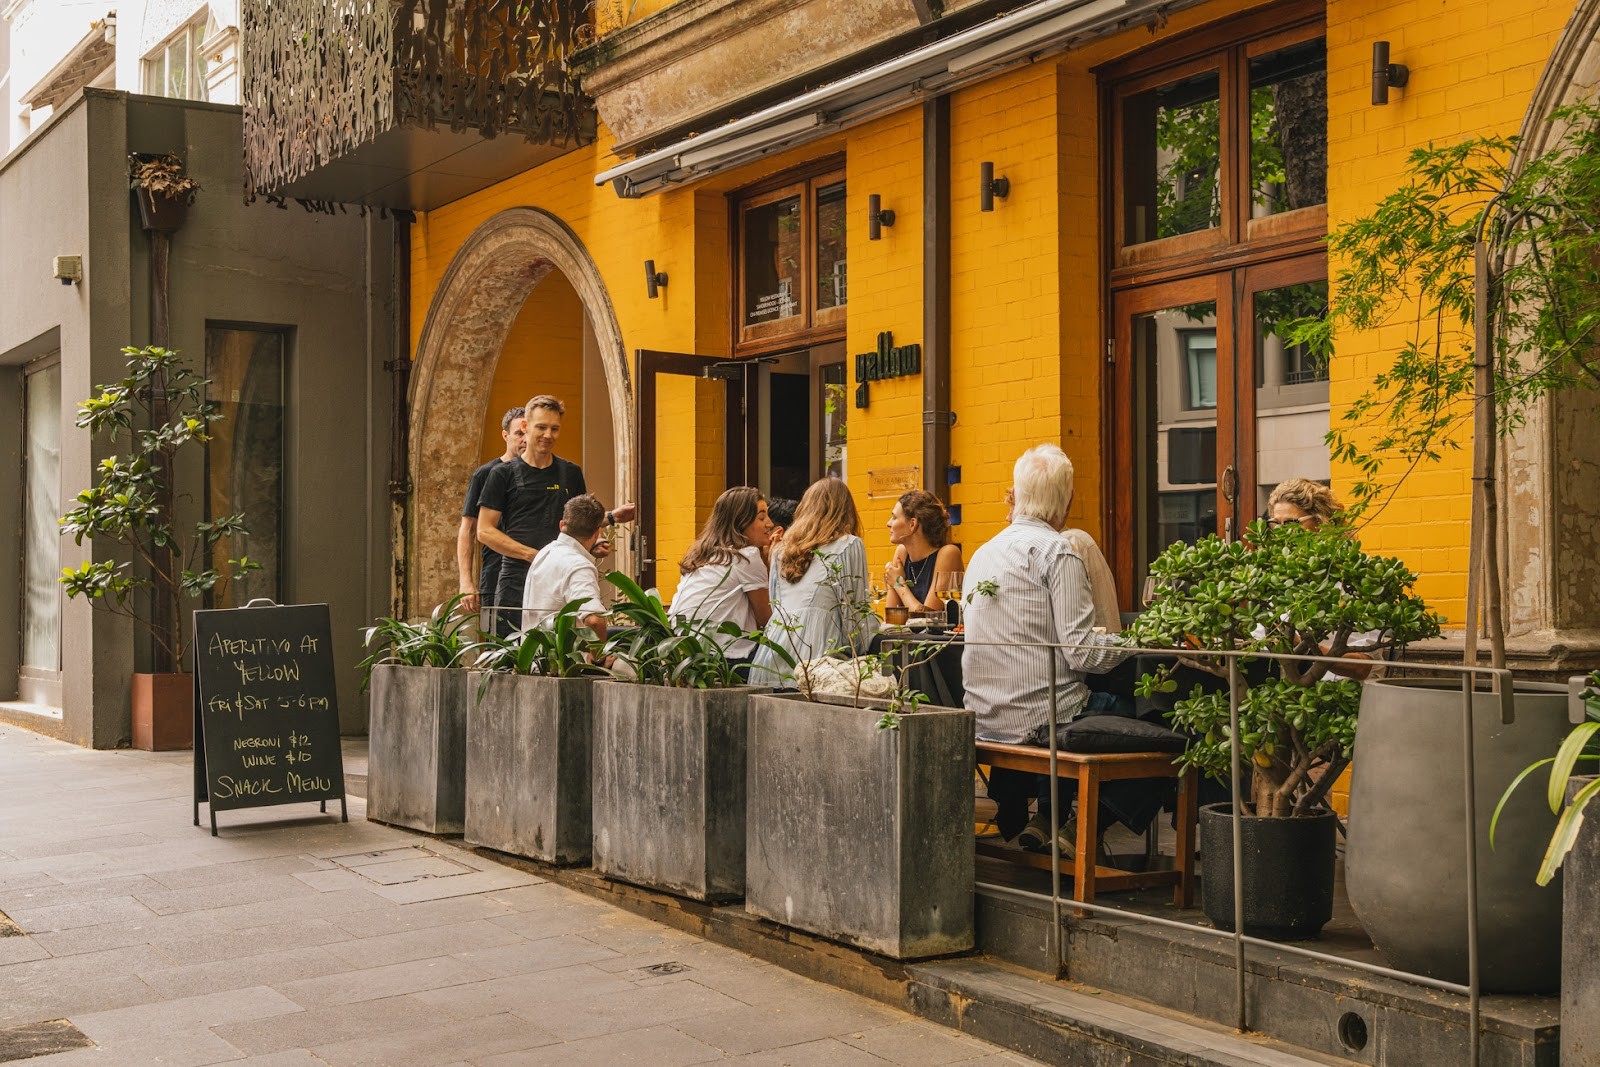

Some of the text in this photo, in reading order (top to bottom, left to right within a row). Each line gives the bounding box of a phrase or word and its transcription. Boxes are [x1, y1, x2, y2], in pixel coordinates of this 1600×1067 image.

[856, 331, 921, 409] yellow
[299, 634, 319, 655] AT
[233, 659, 300, 686] YELLOW
[233, 730, 312, 751] NEGRONI $12
[242, 750, 312, 769] WINE $10
[213, 771, 331, 799] SNACK MENU
